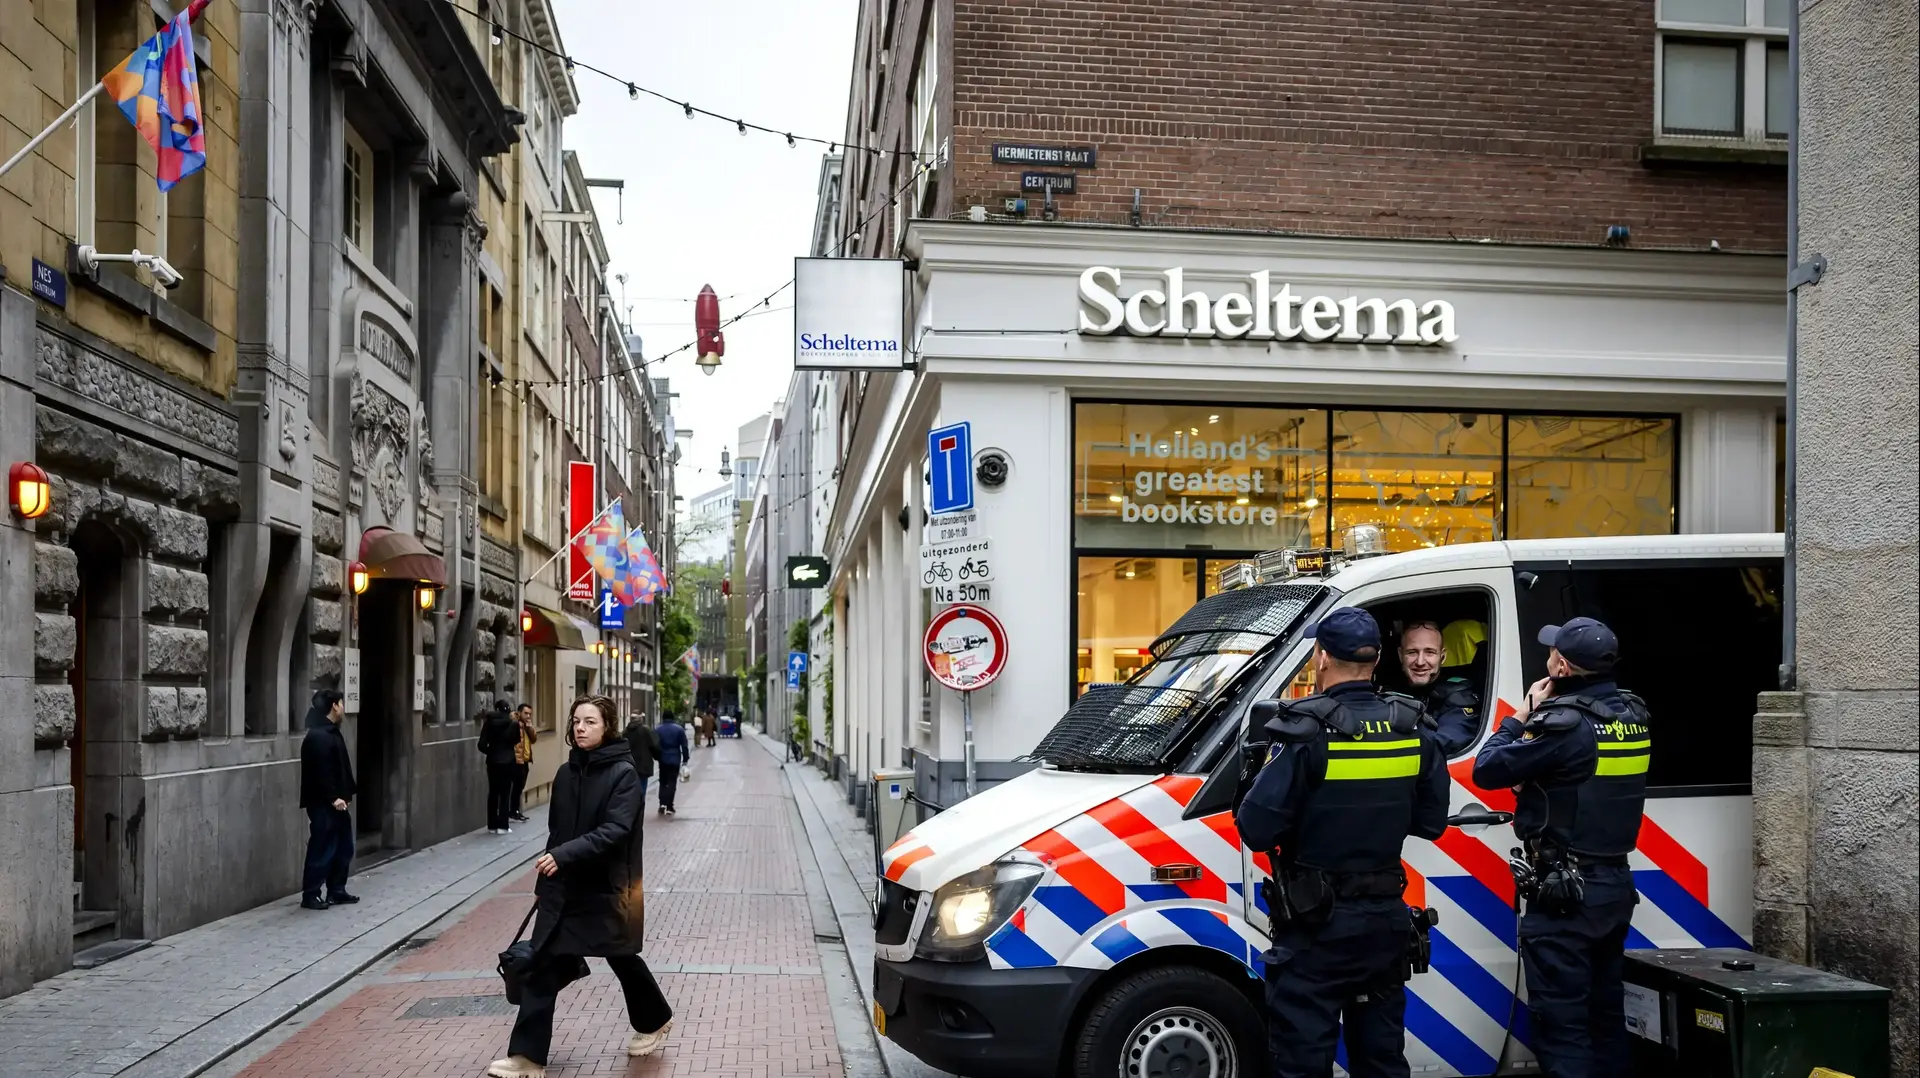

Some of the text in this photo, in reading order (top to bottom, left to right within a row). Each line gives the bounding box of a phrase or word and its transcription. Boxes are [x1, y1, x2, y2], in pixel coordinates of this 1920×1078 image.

[998, 146, 1089, 163] HERMIETENSTRAAT
[1025, 176, 1072, 189] CENTRUM
[37, 264, 52, 284] NES
[33, 280, 56, 299] CENTRUM
[1078, 265, 1459, 346] Scheltema
[800, 333, 898, 351] Scheltema
[1129, 432, 1271, 461] Holland's
[1135, 469, 1264, 496] greatest
[1122, 496, 1277, 525] bookstore
[930, 514, 977, 527] Met uitzondering van
[941, 527, 968, 540] 07:00-11:00
[922, 541, 989, 558] uitgezonderd
[935, 584, 990, 602] Na 50m
